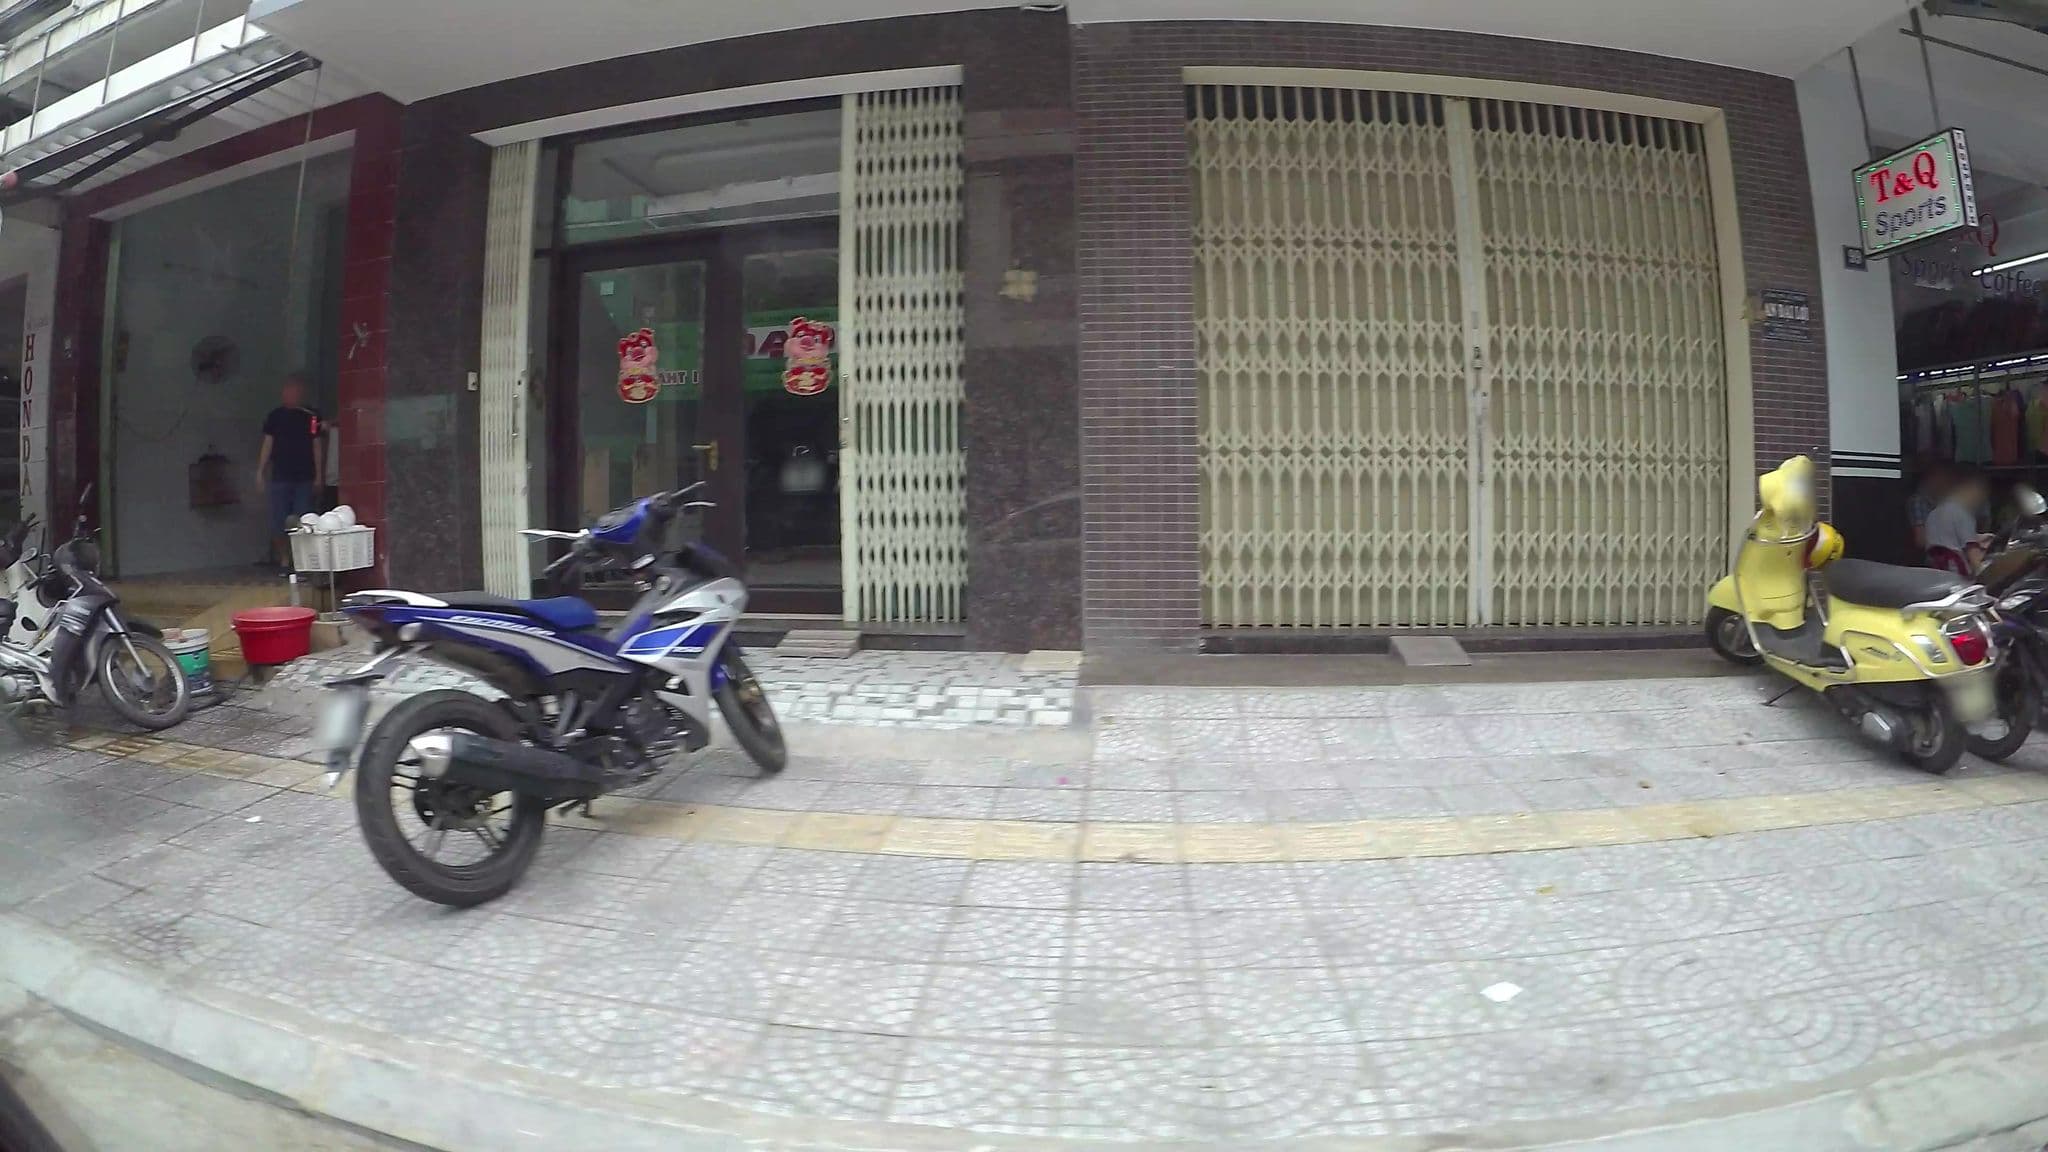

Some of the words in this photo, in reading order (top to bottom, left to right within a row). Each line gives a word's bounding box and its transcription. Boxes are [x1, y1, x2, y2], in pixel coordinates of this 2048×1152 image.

[1869, 151, 1938, 203] T&Q
[1875, 196, 1946, 238] Sports
[1980, 264, 2041, 296] Coffee
[22, 333, 36, 497] HONDA
